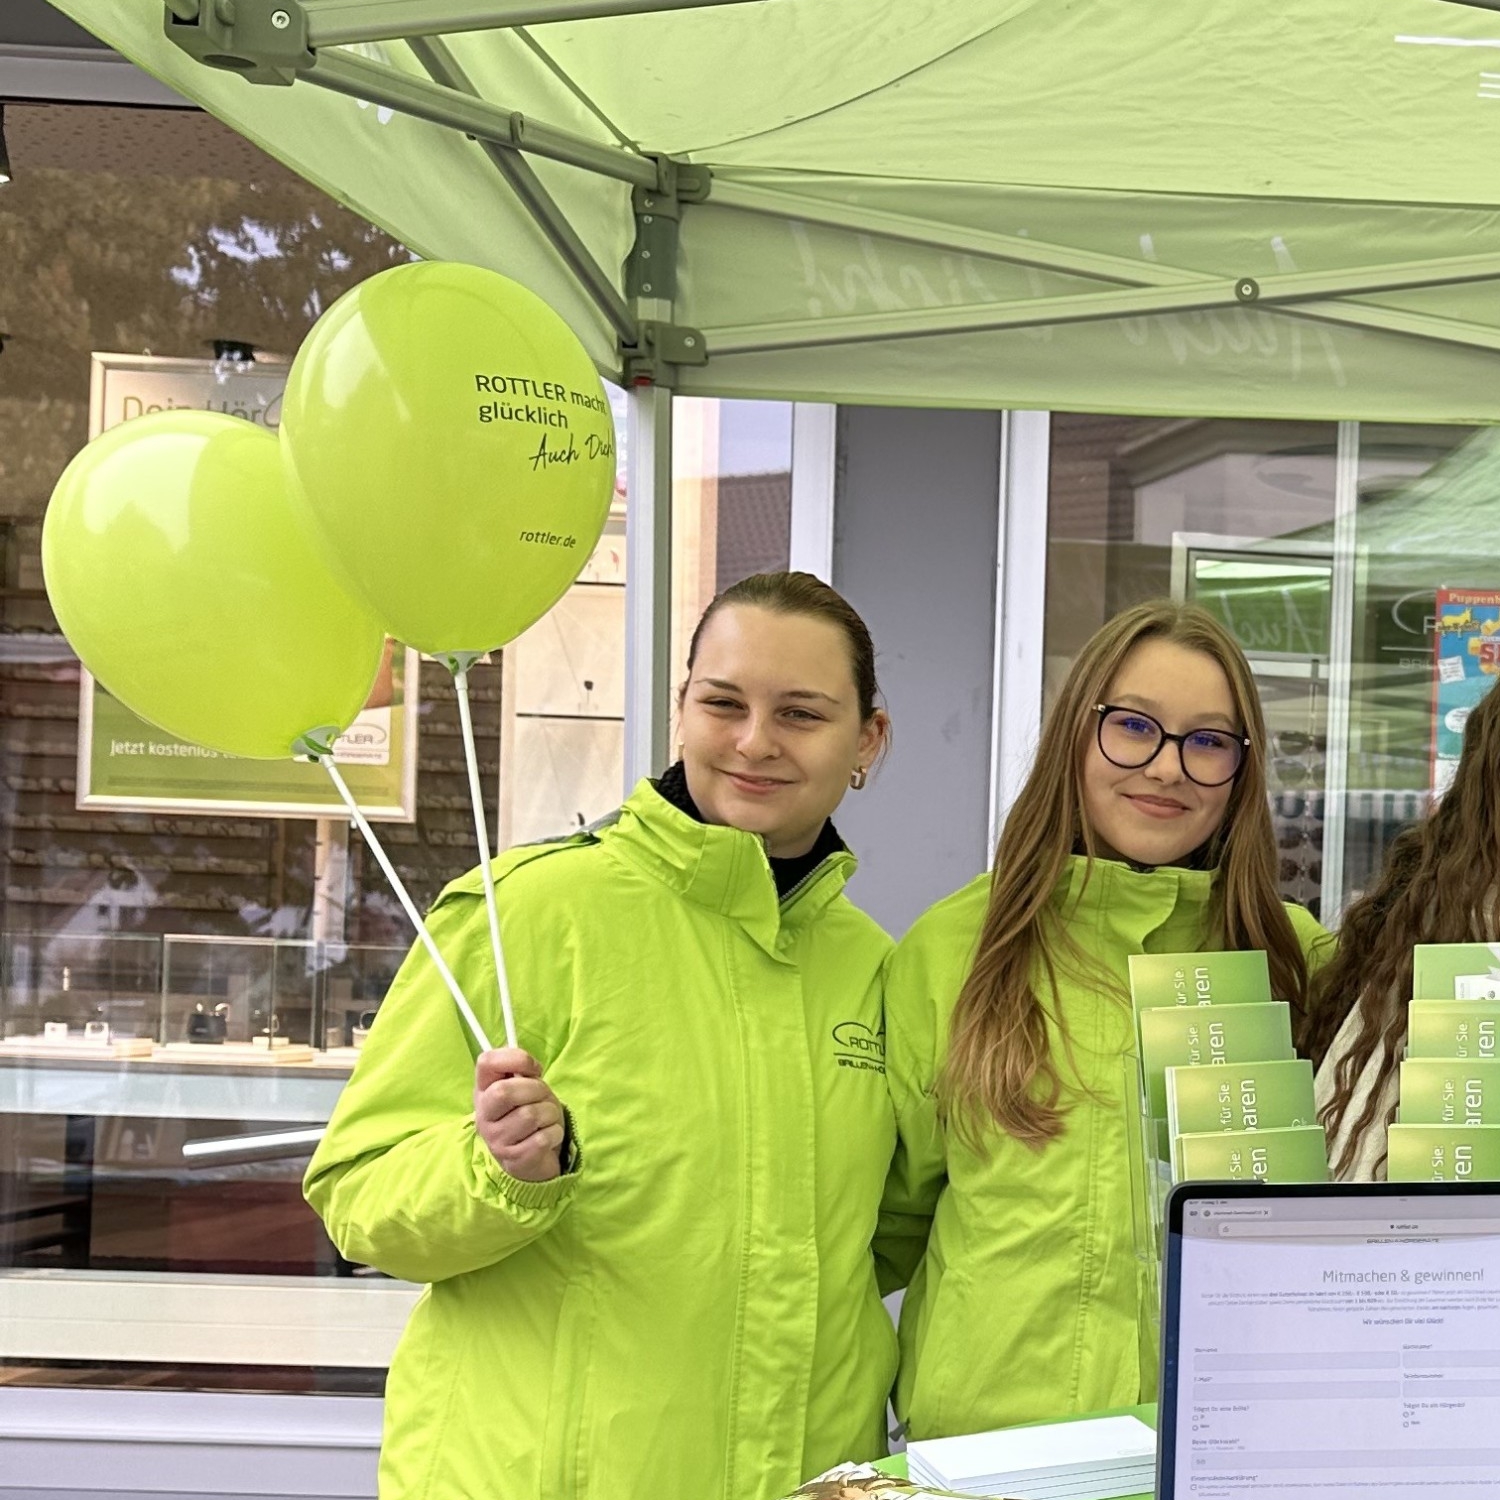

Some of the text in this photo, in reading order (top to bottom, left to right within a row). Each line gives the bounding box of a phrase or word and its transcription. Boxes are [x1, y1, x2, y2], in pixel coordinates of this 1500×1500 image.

[475, 375, 567, 403] ROTTLER
[479, 402, 568, 429] glücklich
[529, 433, 580, 471] Auch
[520, 531, 576, 548] rottler.de
[1195, 967, 1211, 1007] aren
[849, 1036, 885, 1056] ROTTL
[1209, 1022, 1226, 1065] aren
[1478, 1019, 1495, 1057] ren
[1464, 1079, 1482, 1126] aren
[1323, 1268, 1485, 1284] Mitmachen & gewinnen!
